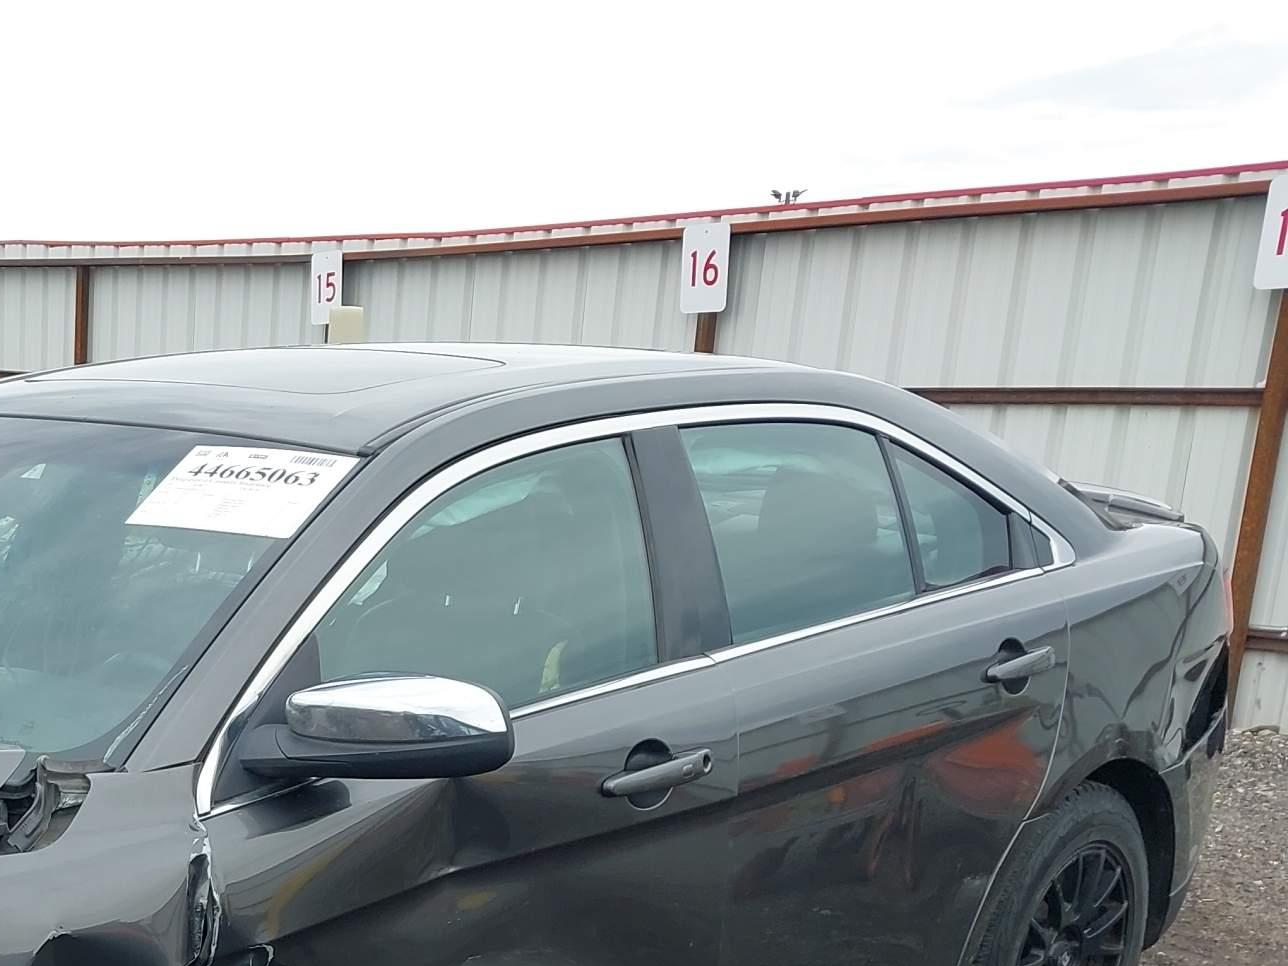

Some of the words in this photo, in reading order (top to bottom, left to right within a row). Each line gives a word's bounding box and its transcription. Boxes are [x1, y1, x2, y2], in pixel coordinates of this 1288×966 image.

[690, 249, 719, 287] 16
[317, 271, 337, 304] 15
[188, 462, 321, 488] 44665063
